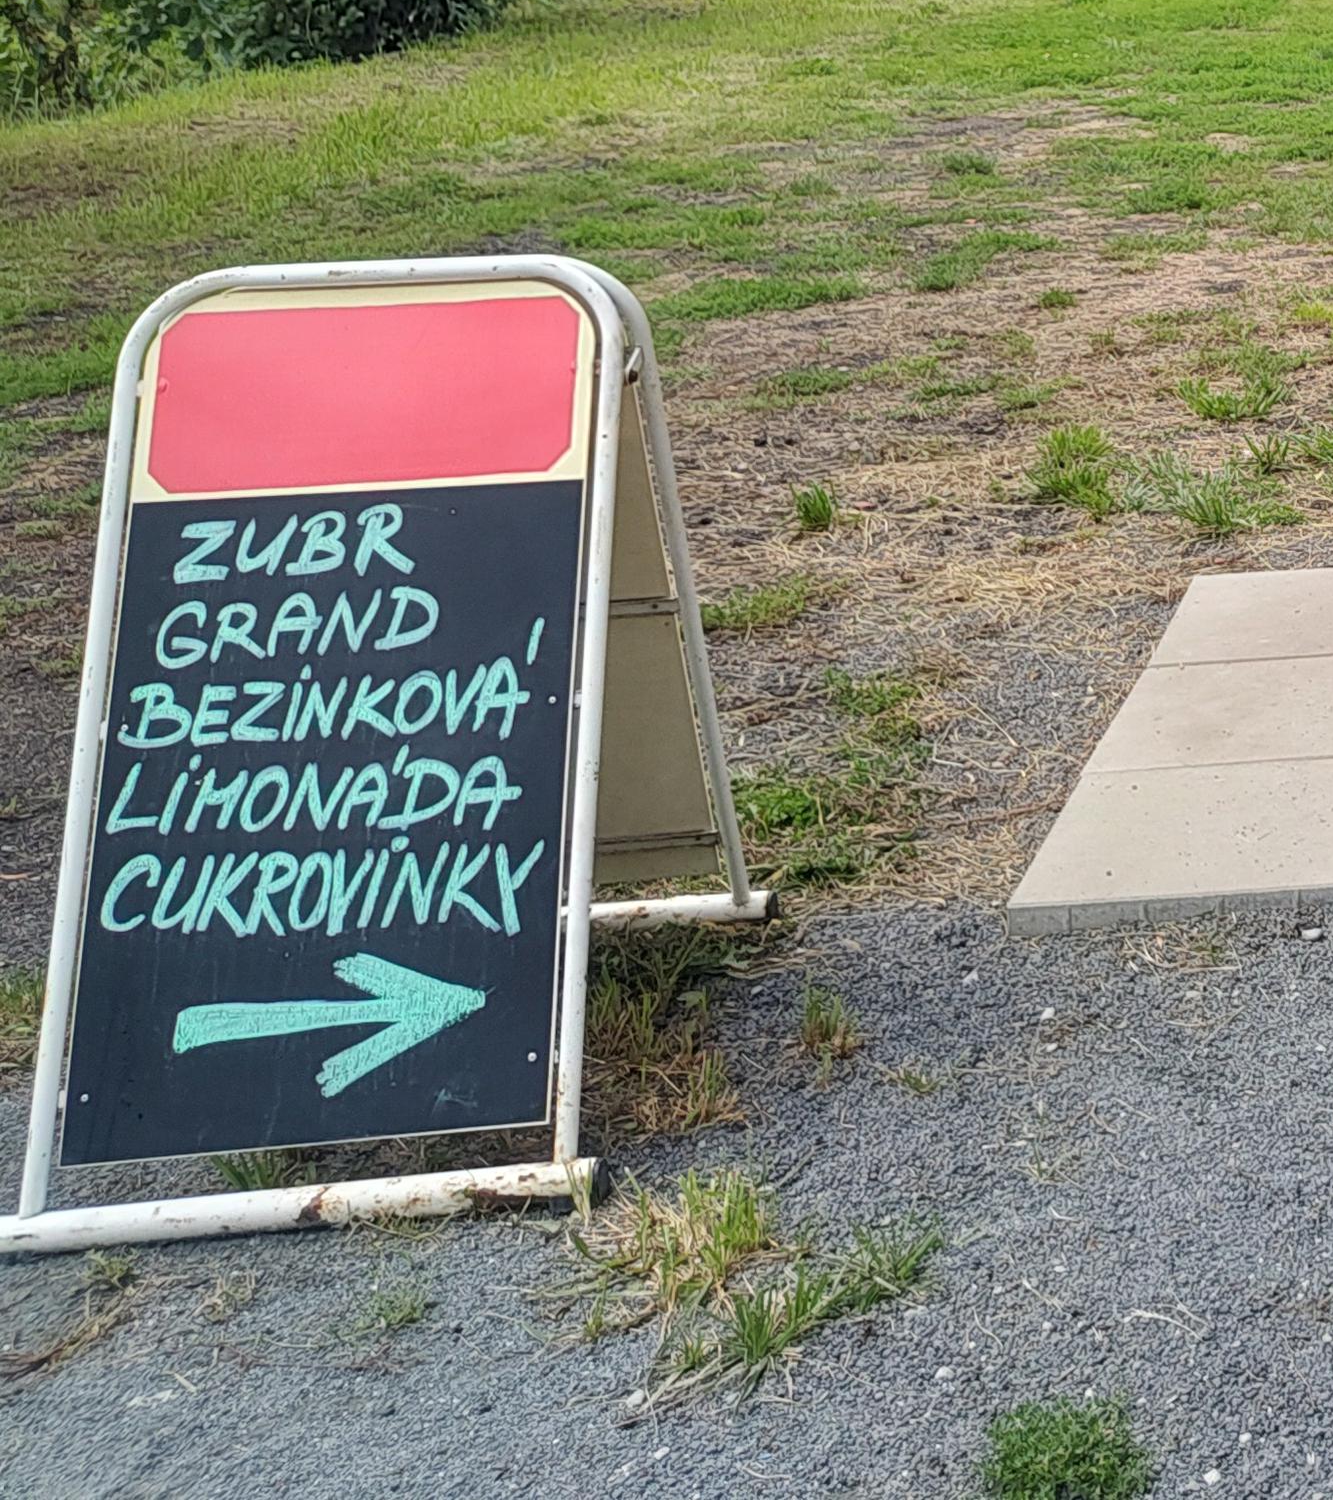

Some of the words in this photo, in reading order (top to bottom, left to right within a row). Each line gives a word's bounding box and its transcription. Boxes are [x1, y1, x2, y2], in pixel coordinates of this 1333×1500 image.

[173, 503, 416, 585] ZUBR
[155, 585, 440, 670] GRAND
[100, 836, 545, 938] CUKROVINKY
